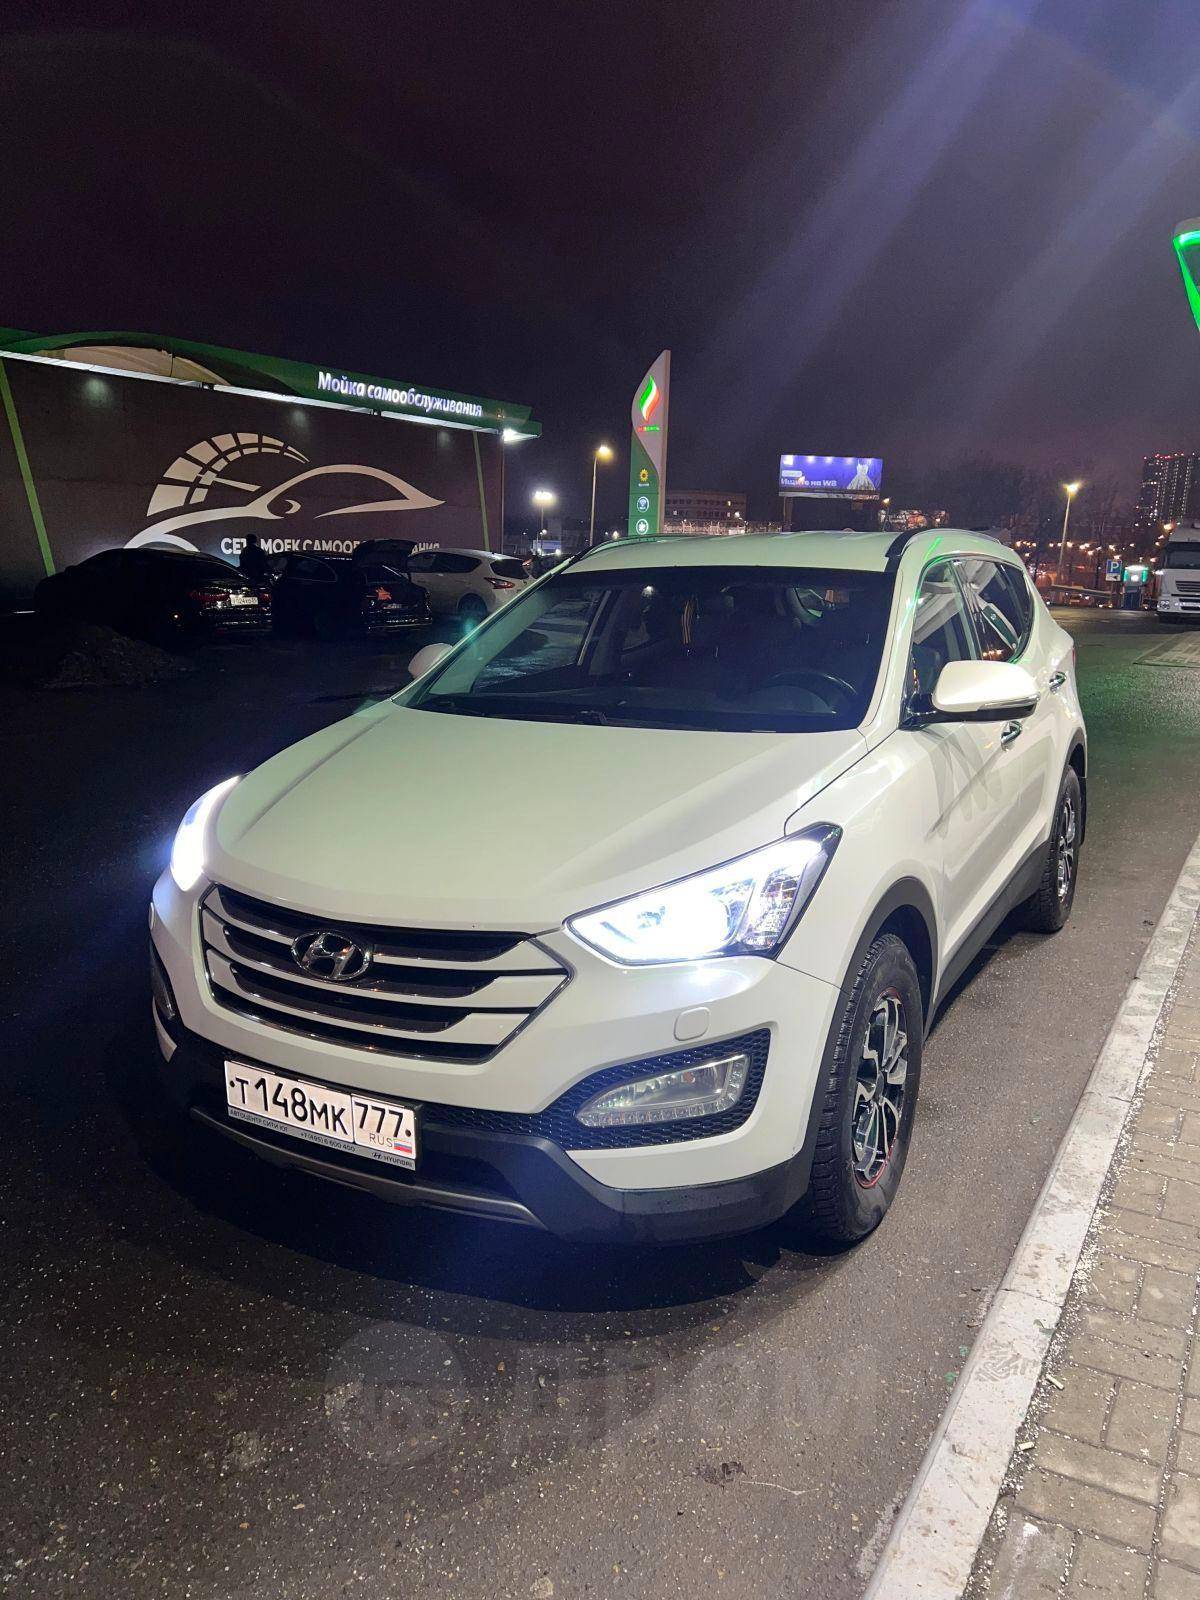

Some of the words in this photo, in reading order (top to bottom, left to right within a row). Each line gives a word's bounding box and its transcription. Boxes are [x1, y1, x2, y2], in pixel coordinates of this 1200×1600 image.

[317, 371, 365, 396] Мойка
[367, 386, 483, 417] самообслуживания
[260, 538, 300, 554] МОЕК
[1110, 561, 1119, 572] P
[235, 1077, 348, 1135] Т148МК
[354, 1102, 403, 1137] 777
[368, 1132, 393, 1148] RUS
